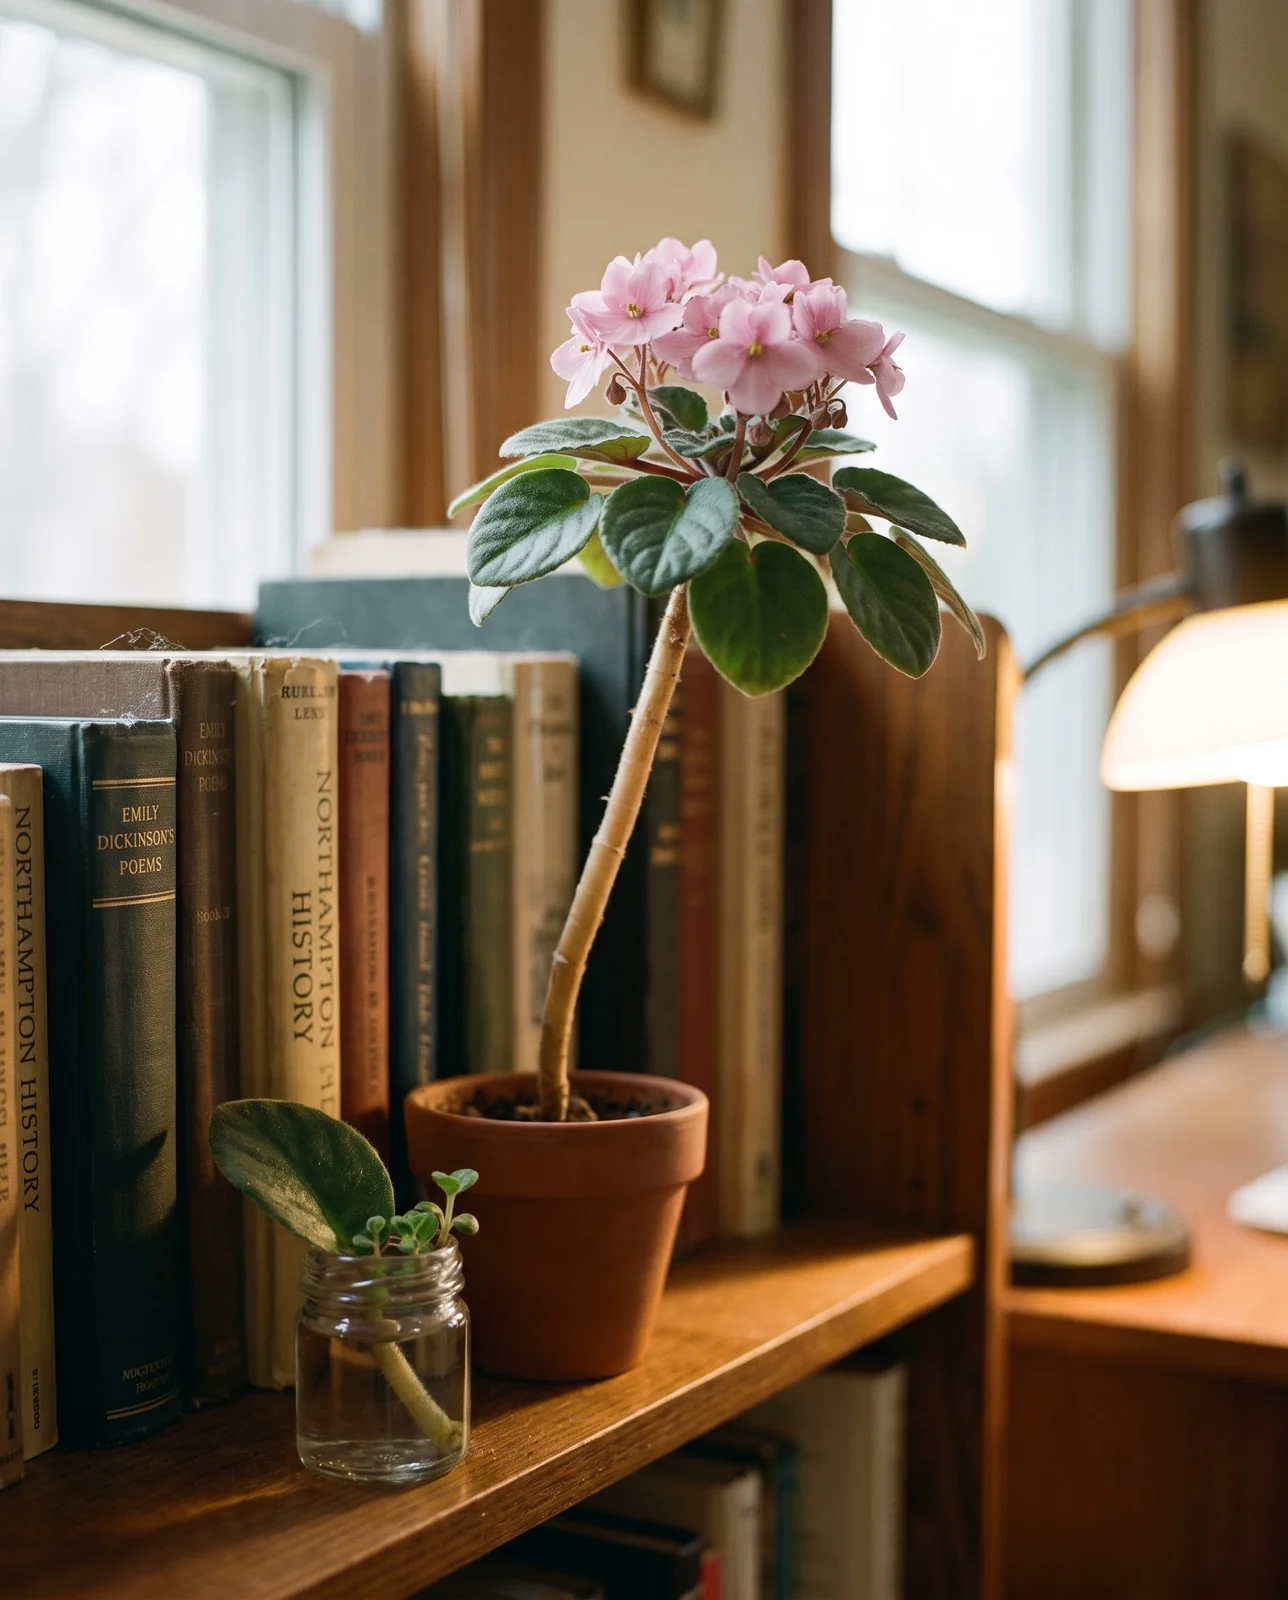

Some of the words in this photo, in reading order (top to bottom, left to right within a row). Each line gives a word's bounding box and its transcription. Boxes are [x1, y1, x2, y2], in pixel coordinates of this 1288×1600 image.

[200, 722, 227, 739] EMILY
[97, 828, 176, 851] DICKINSON'S
[122, 804, 160, 823] EMILY
[120, 856, 163, 876] POEMS
[15, 804, 36, 1064] NORTHAMPTON
[317, 769, 335, 1049] NORTHAMPTON
[292, 889, 314, 1044] HISTORY
[20, 1077, 40, 1213] HISTORY
